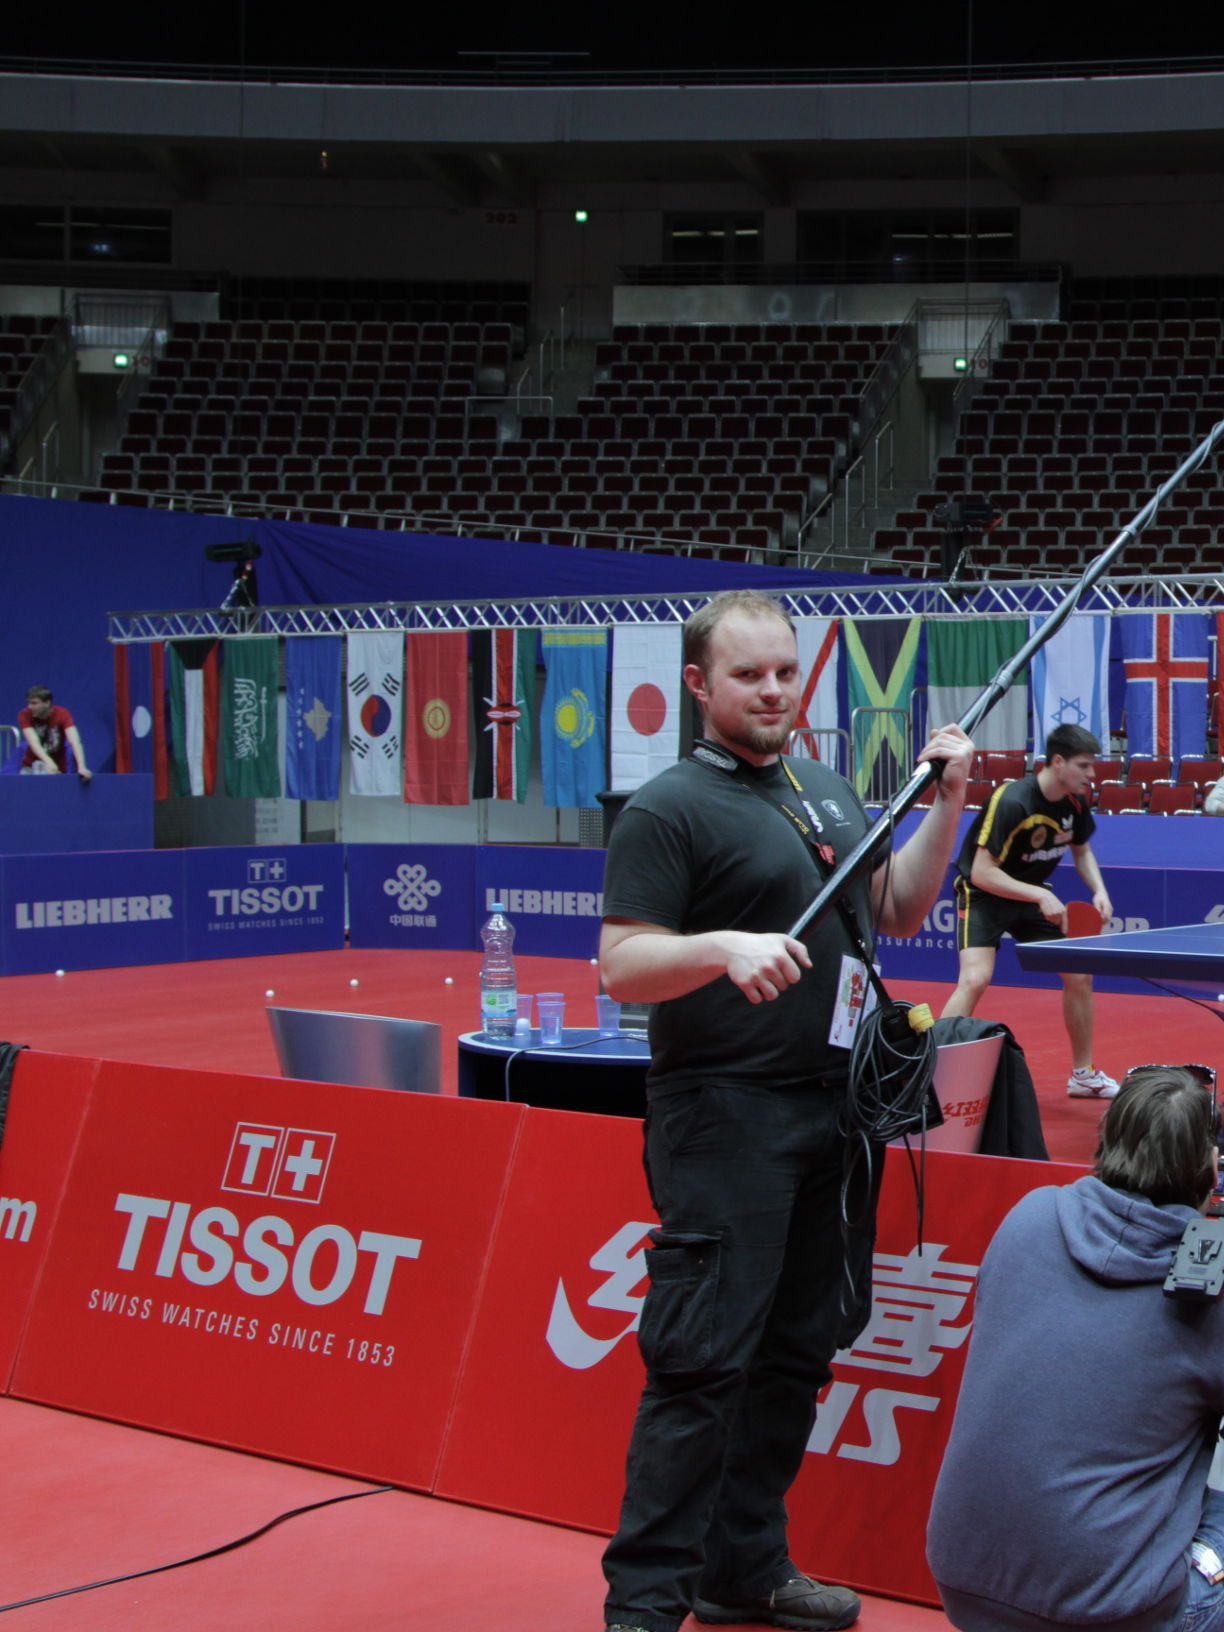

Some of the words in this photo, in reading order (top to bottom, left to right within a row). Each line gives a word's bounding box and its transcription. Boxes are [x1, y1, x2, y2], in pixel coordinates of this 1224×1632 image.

[485, 212, 517, 225] 202
[15, 894, 174, 930] LIEBHERR
[208, 885, 324, 916] TISSOT
[486, 888, 604, 917] LIEBHER
[114, 1193, 422, 1315] TISSOT
[88, 1289, 152, 1320] SWISS
[162, 1302, 258, 1340] WATCHES
[268, 1323, 335, 1355] SINCE
[346, 1338, 396, 1367] 1853
